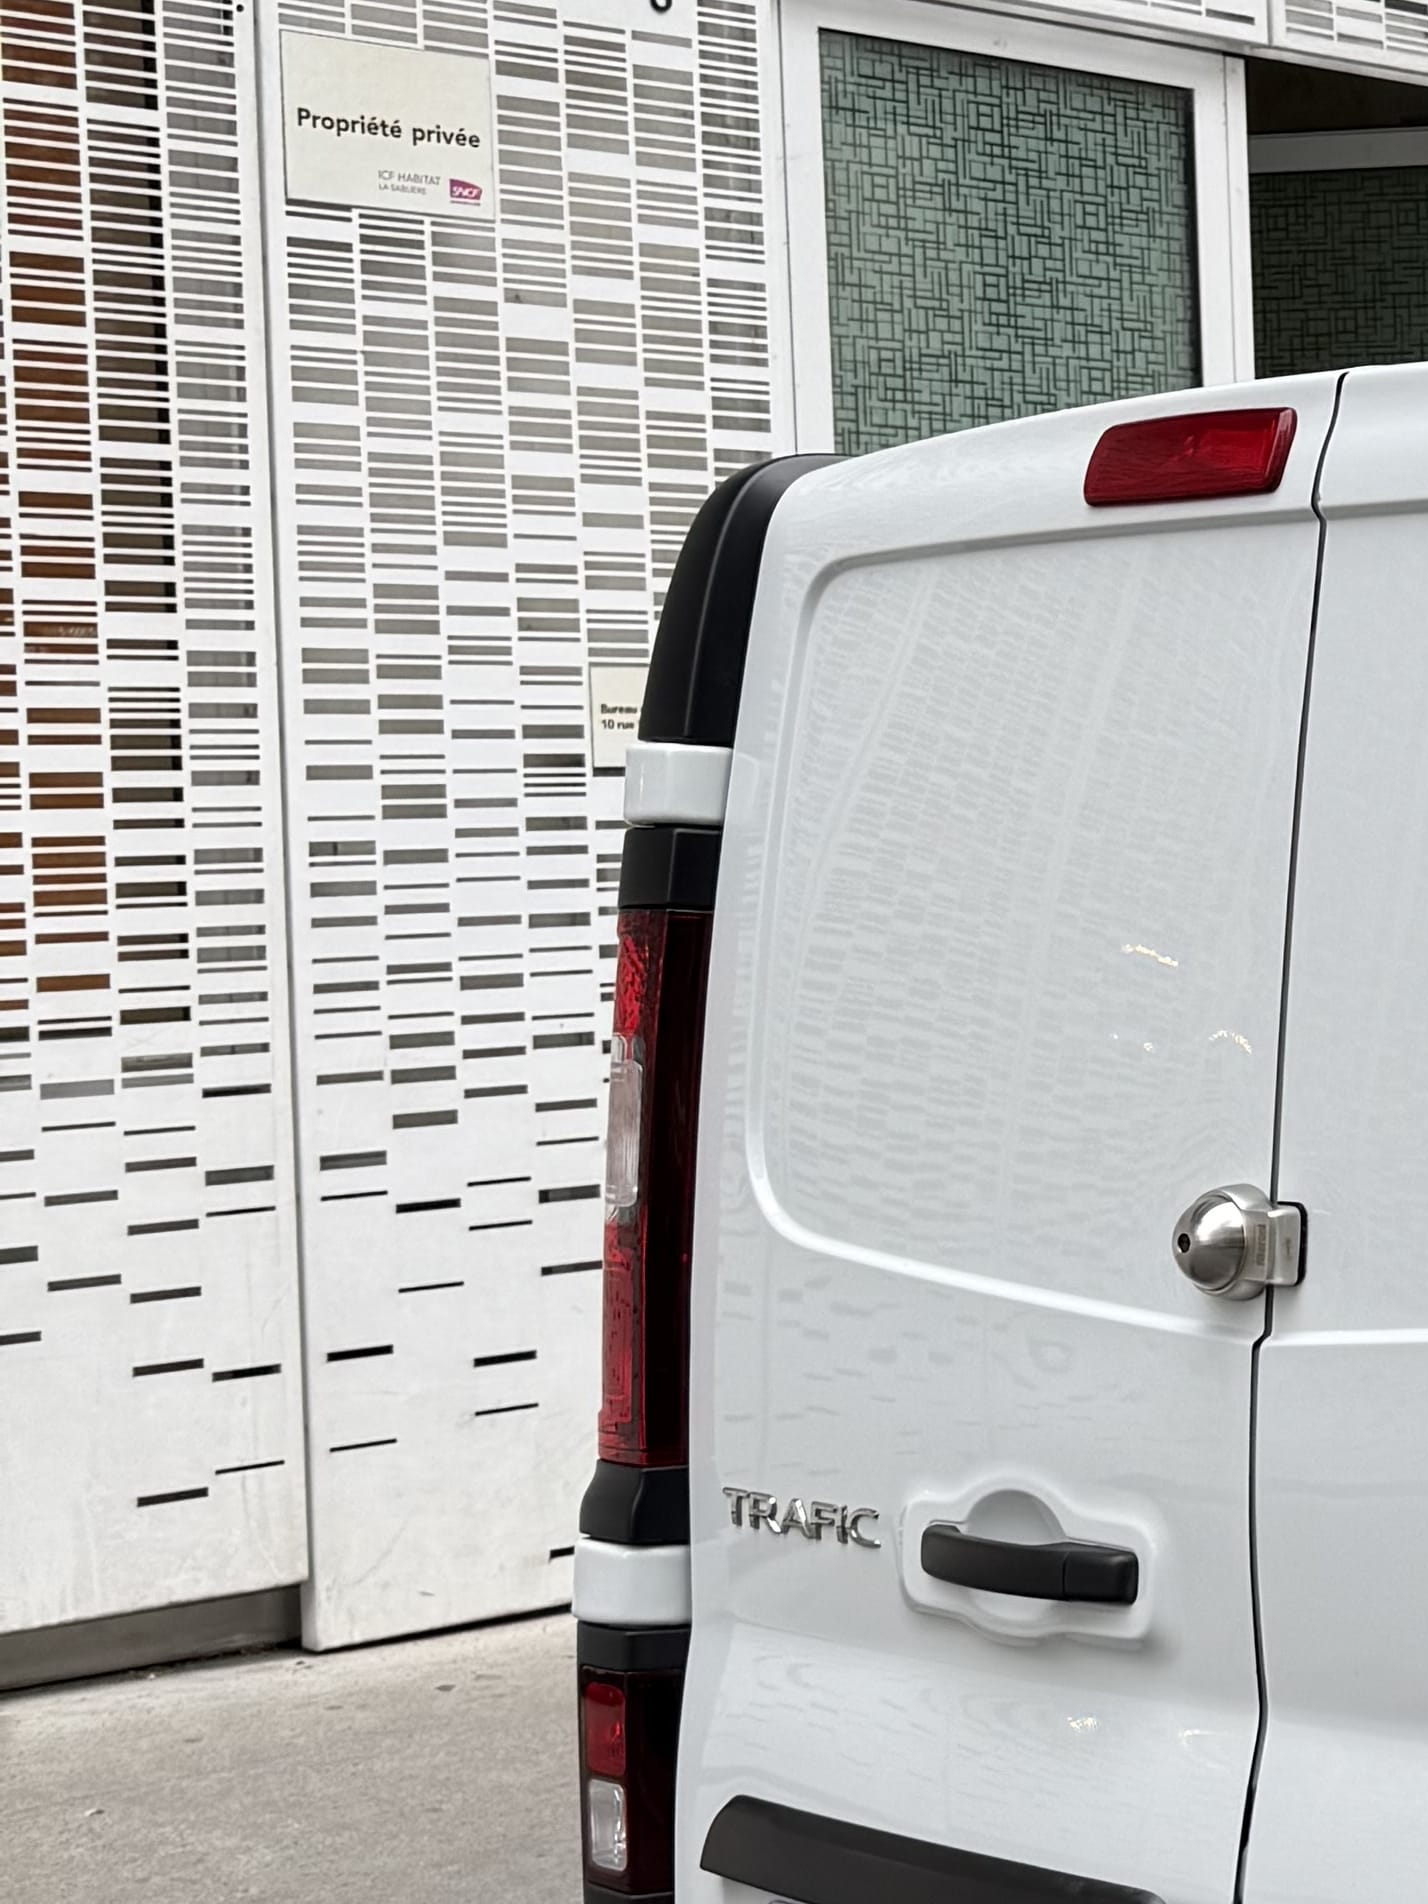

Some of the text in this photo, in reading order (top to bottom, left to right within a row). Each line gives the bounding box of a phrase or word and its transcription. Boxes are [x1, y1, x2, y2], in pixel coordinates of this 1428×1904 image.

[297, 107, 480, 147] Propriété privée
[601, 703, 638, 714] Bureau
[601, 719, 615, 729] 10
[722, 1486, 882, 1550] TRAFIC
